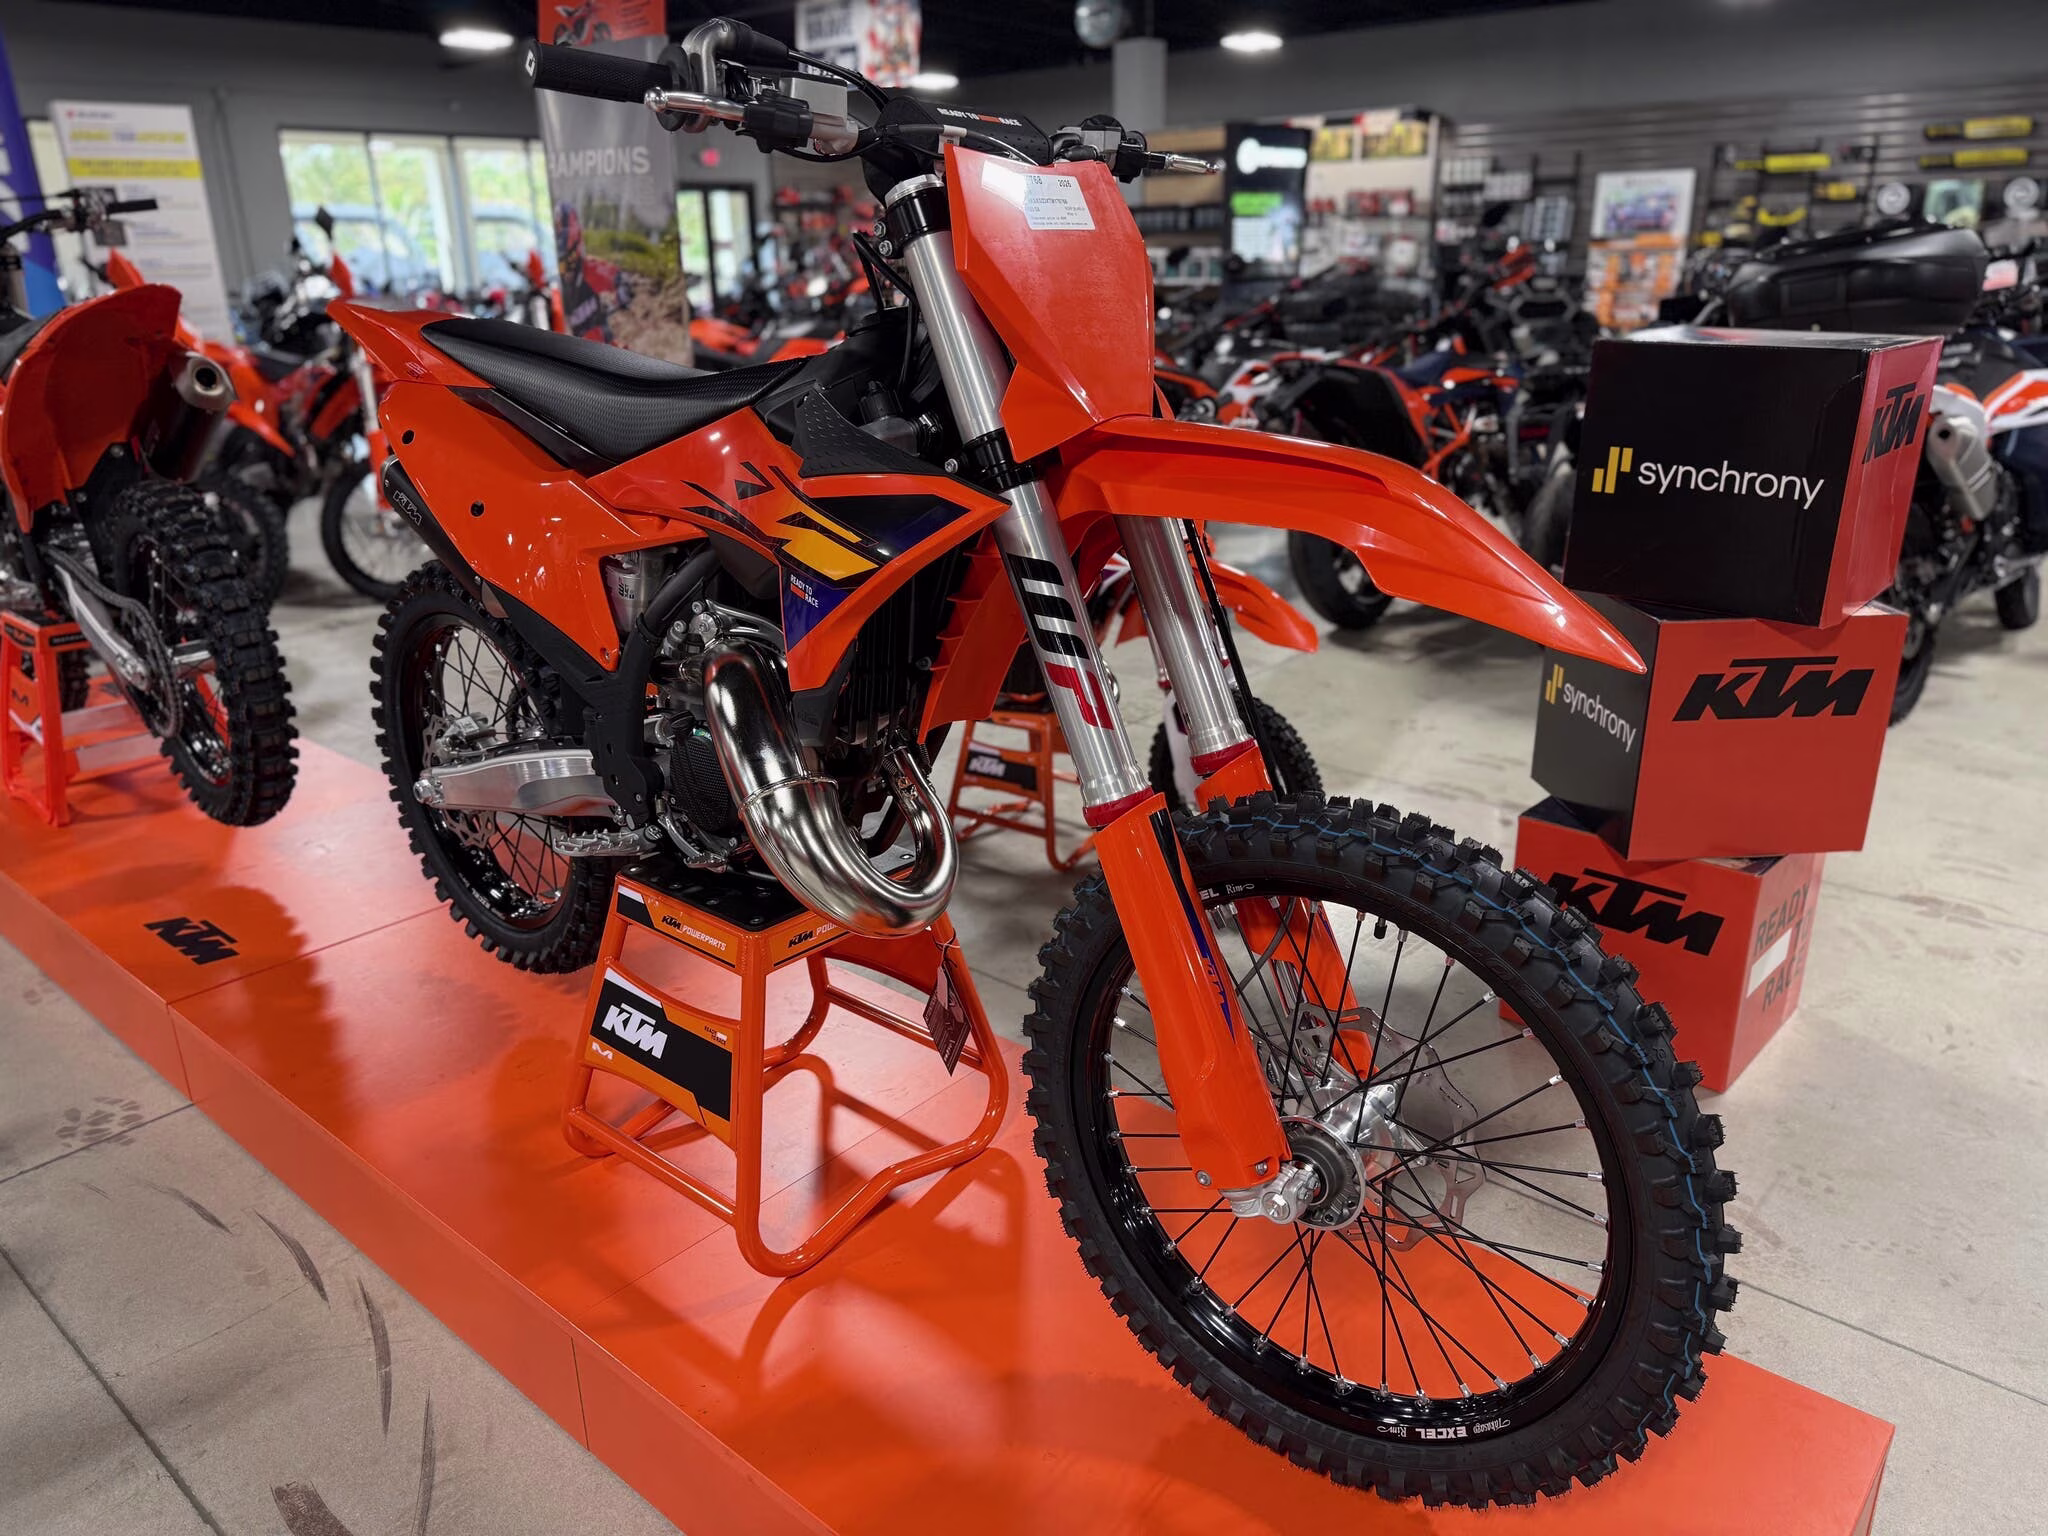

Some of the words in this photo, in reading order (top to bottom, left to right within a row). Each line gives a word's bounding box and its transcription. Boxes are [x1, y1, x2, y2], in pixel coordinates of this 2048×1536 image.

[1862, 382, 1926, 465] KTM
[1638, 460, 1825, 510] synchrony
[790, 574, 806, 591] READY
[805, 584, 813, 595] TO
[804, 593, 819, 608] RACE
[1672, 656, 1875, 722] KTM
[1563, 682, 1636, 753] synchrony
[662, 915, 681, 930] KTM
[682, 925, 727, 951] POWERPARTS
[1546, 867, 1725, 957] KTM
[1753, 882, 1809, 957] READY
[143, 916, 241, 965] KTM
[788, 929, 814, 948] KTM
[602, 1002, 668, 1060] KTM
[1415, 1426, 1469, 1440] EXCEL
